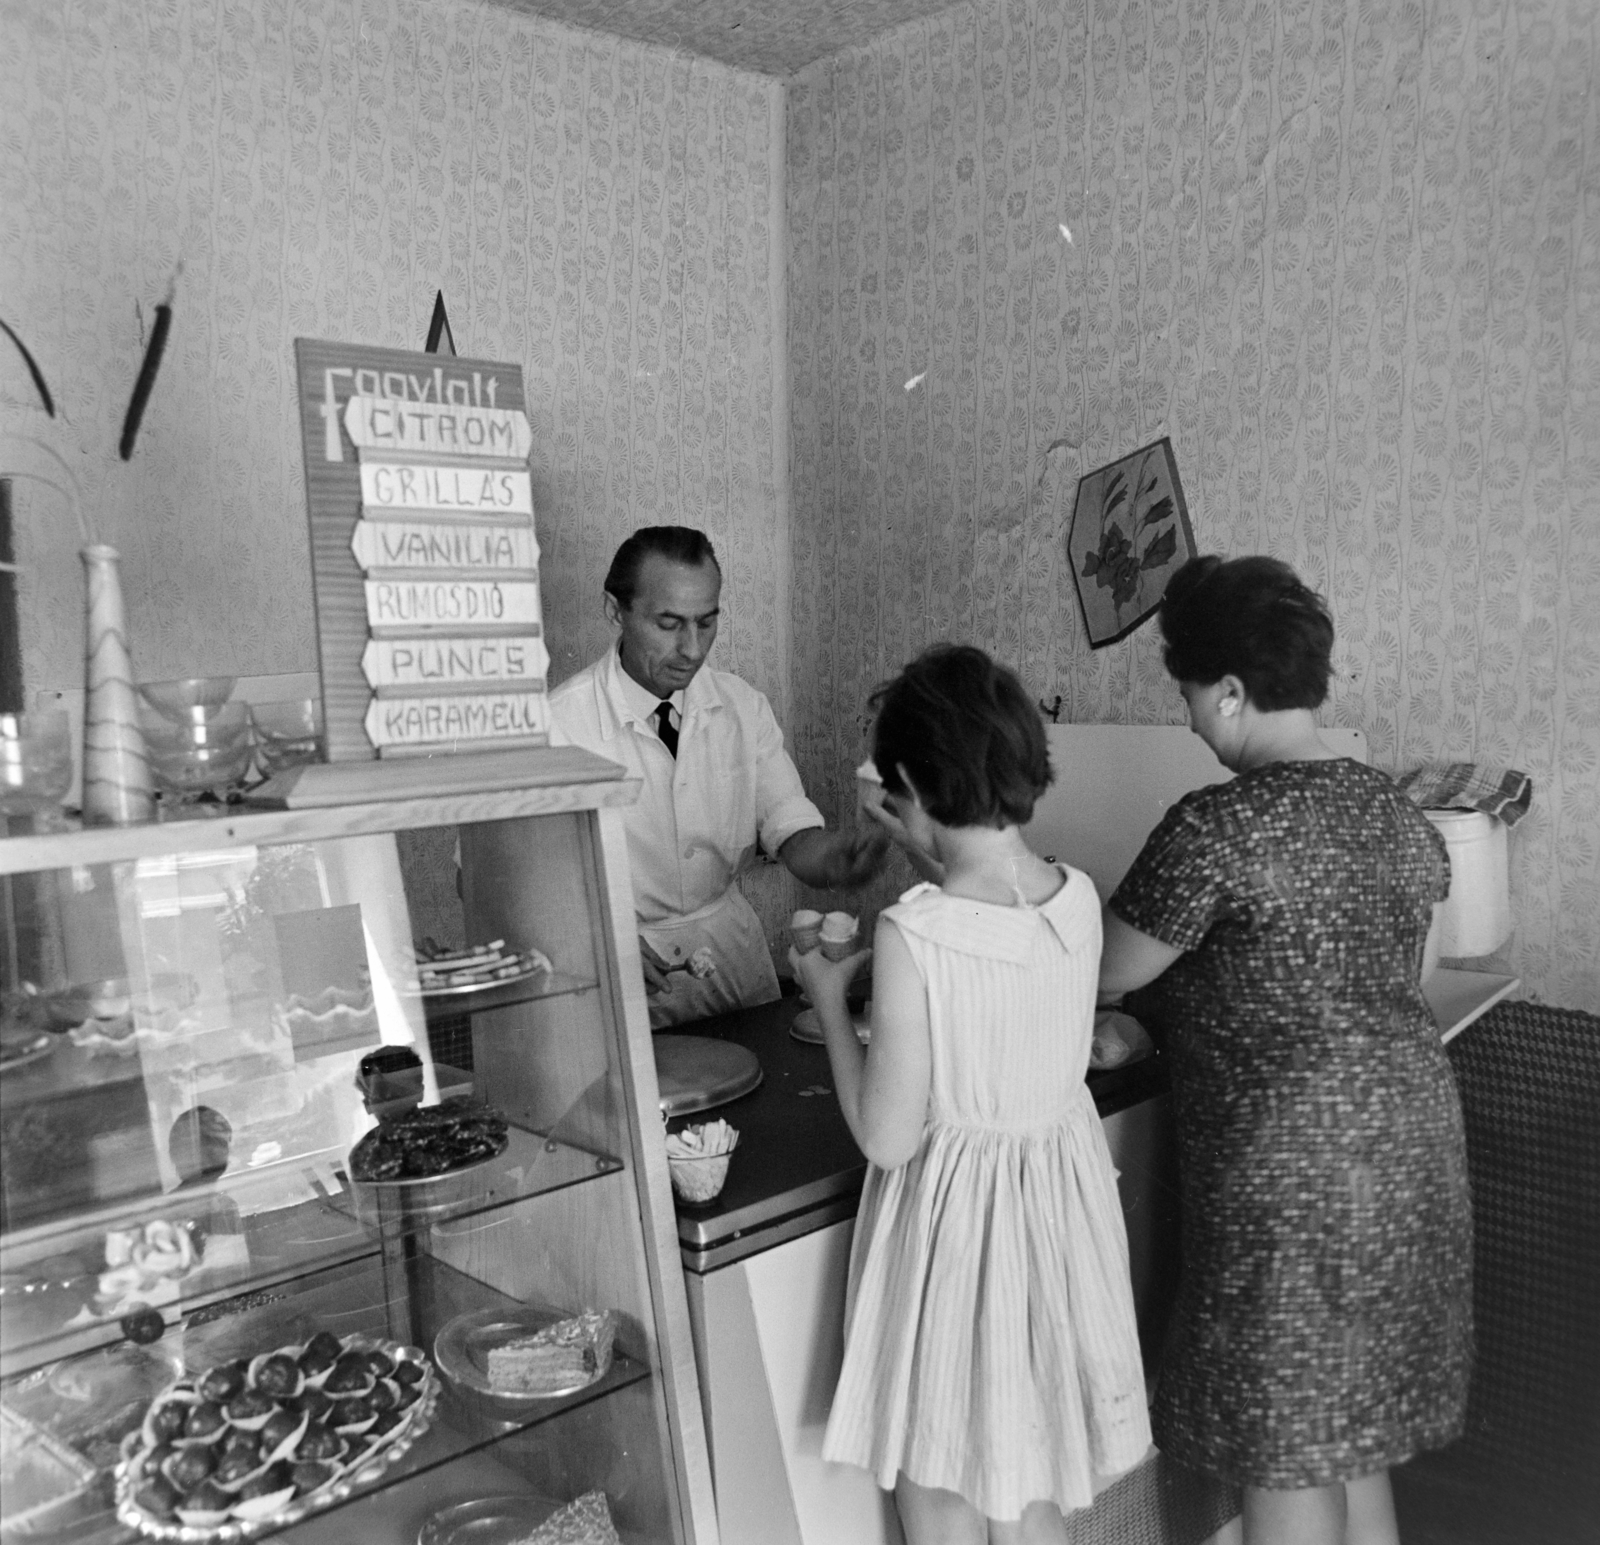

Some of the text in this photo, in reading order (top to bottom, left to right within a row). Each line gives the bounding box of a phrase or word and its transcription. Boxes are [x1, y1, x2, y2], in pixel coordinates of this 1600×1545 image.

[370, 408, 513, 448] CITROM
[381, 532, 515, 565] VANILIA
[392, 646, 525, 678] PUNCS
[384, 702, 536, 737] KARAMELL
